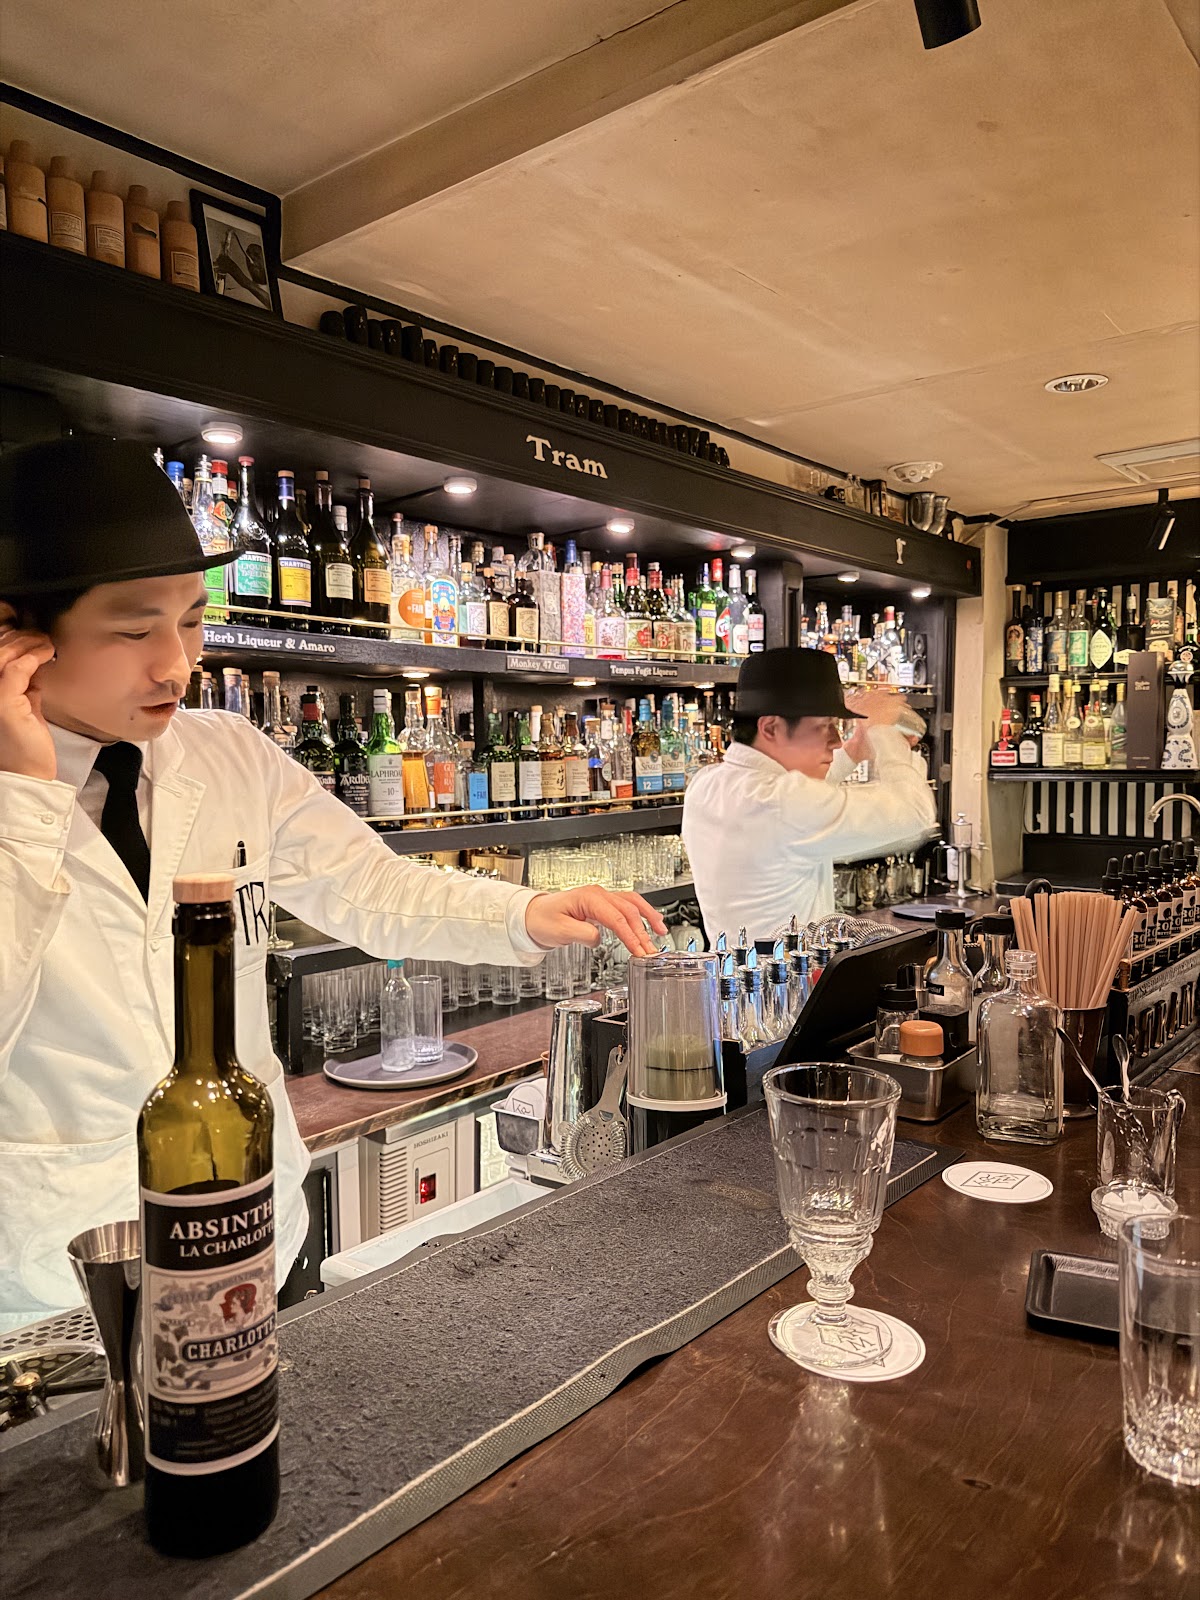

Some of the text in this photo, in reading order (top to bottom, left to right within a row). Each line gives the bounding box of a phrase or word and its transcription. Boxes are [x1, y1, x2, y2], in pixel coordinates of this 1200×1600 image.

[525, 434, 609, 479] Tram
[203, 629, 336, 653] Herb Liqueur & Amaro
[510, 658, 567, 671] Monkey 47 Gin
[642, 780, 652, 790] 12
[663, 778, 673, 788] 15
[180, 1244, 200, 1257] LA
